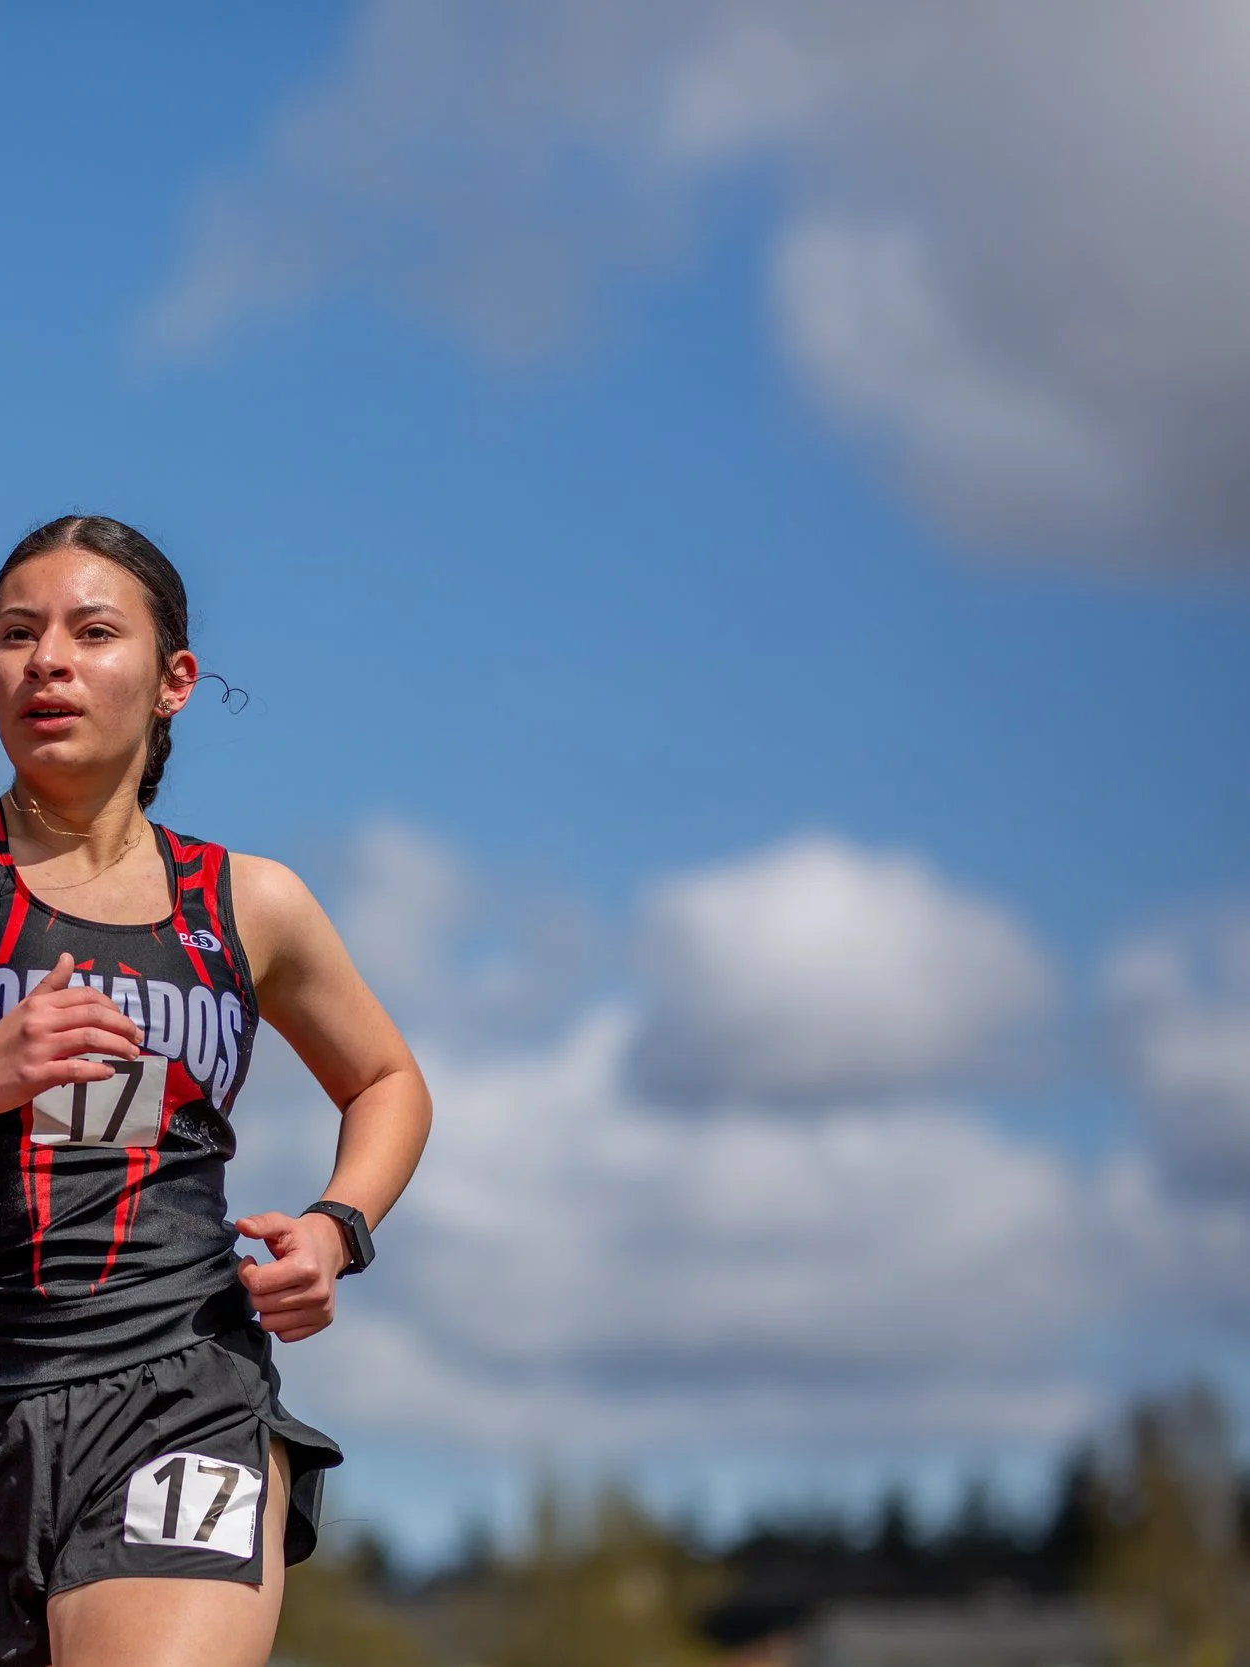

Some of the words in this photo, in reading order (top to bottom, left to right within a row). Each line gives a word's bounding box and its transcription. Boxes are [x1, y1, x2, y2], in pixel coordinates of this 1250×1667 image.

[178, 932, 210, 948] PCS
[60, 1059, 145, 1143] 17
[152, 1457, 241, 1543] 17
